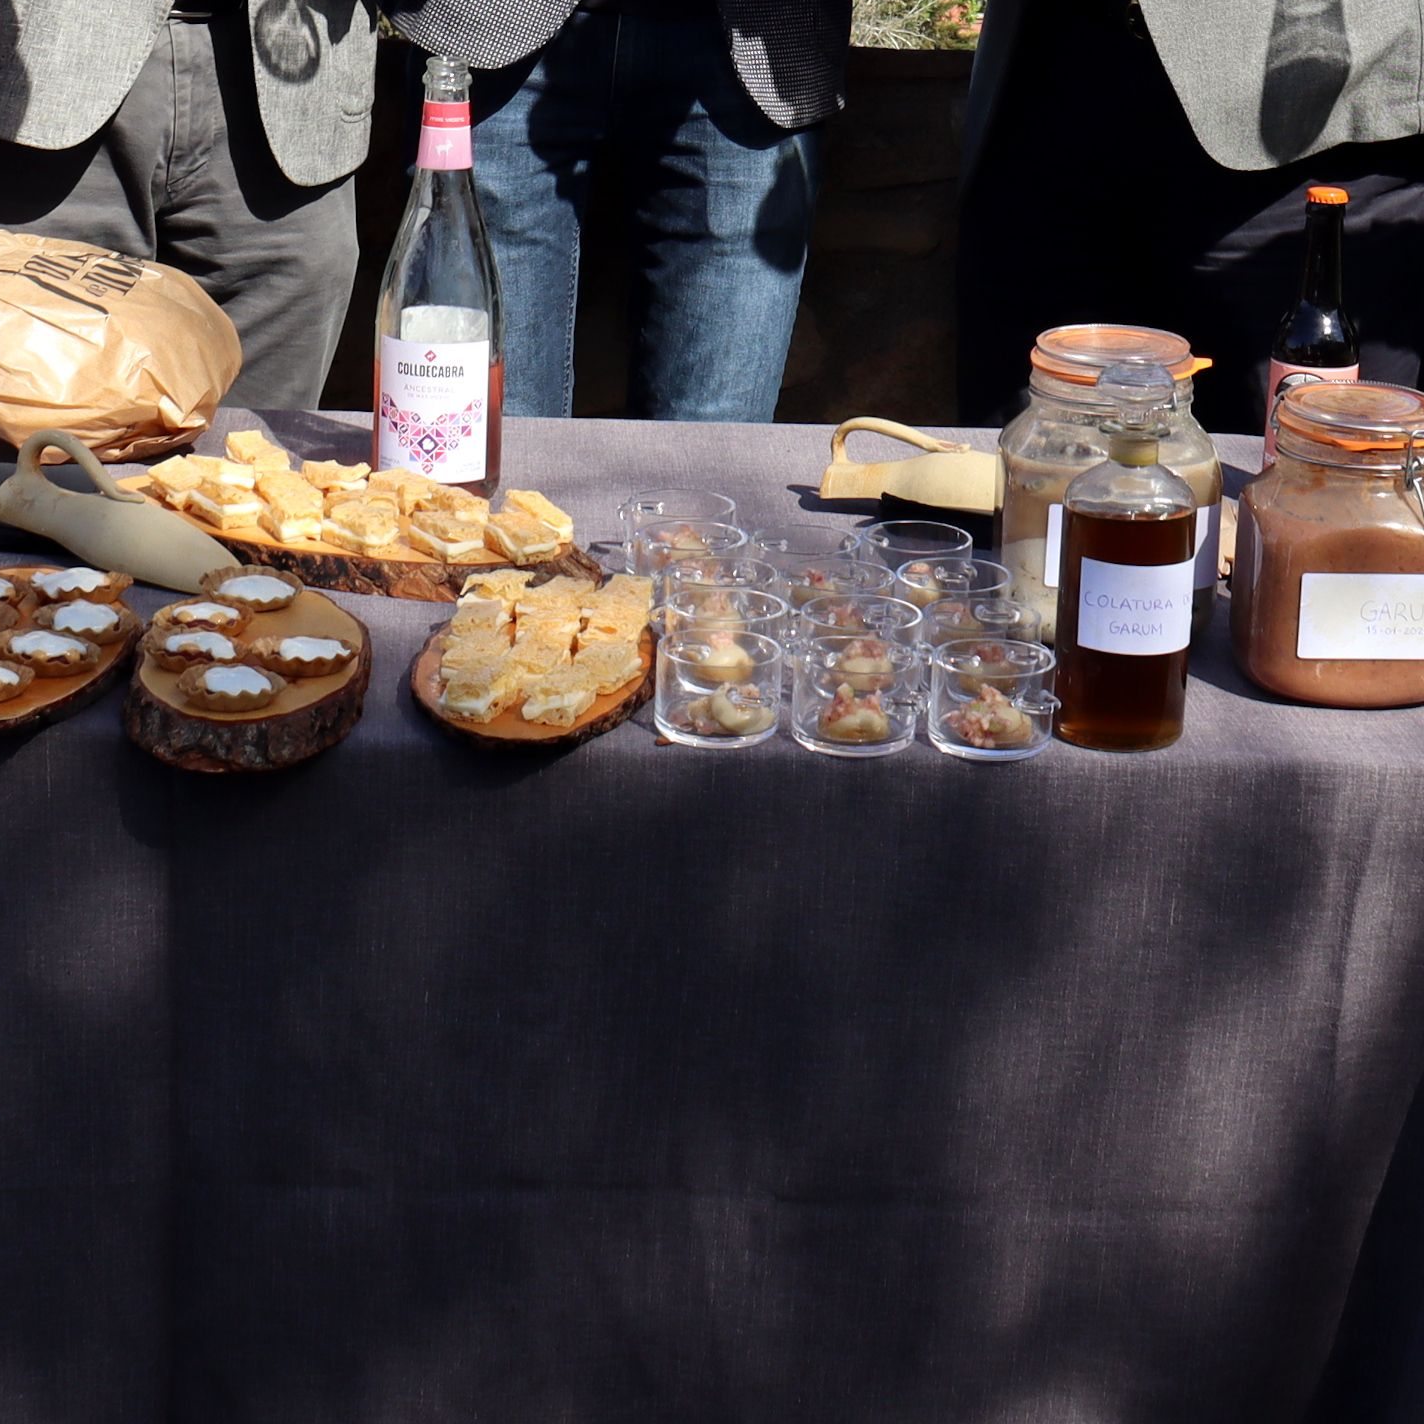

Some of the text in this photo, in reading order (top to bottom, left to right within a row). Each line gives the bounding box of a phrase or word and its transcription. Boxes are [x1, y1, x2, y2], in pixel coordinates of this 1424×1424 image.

[397, 361, 465, 378] COLLDECABRA
[1084, 591, 1174, 612] COLATURA
[1109, 620, 1164, 636] GARUM
